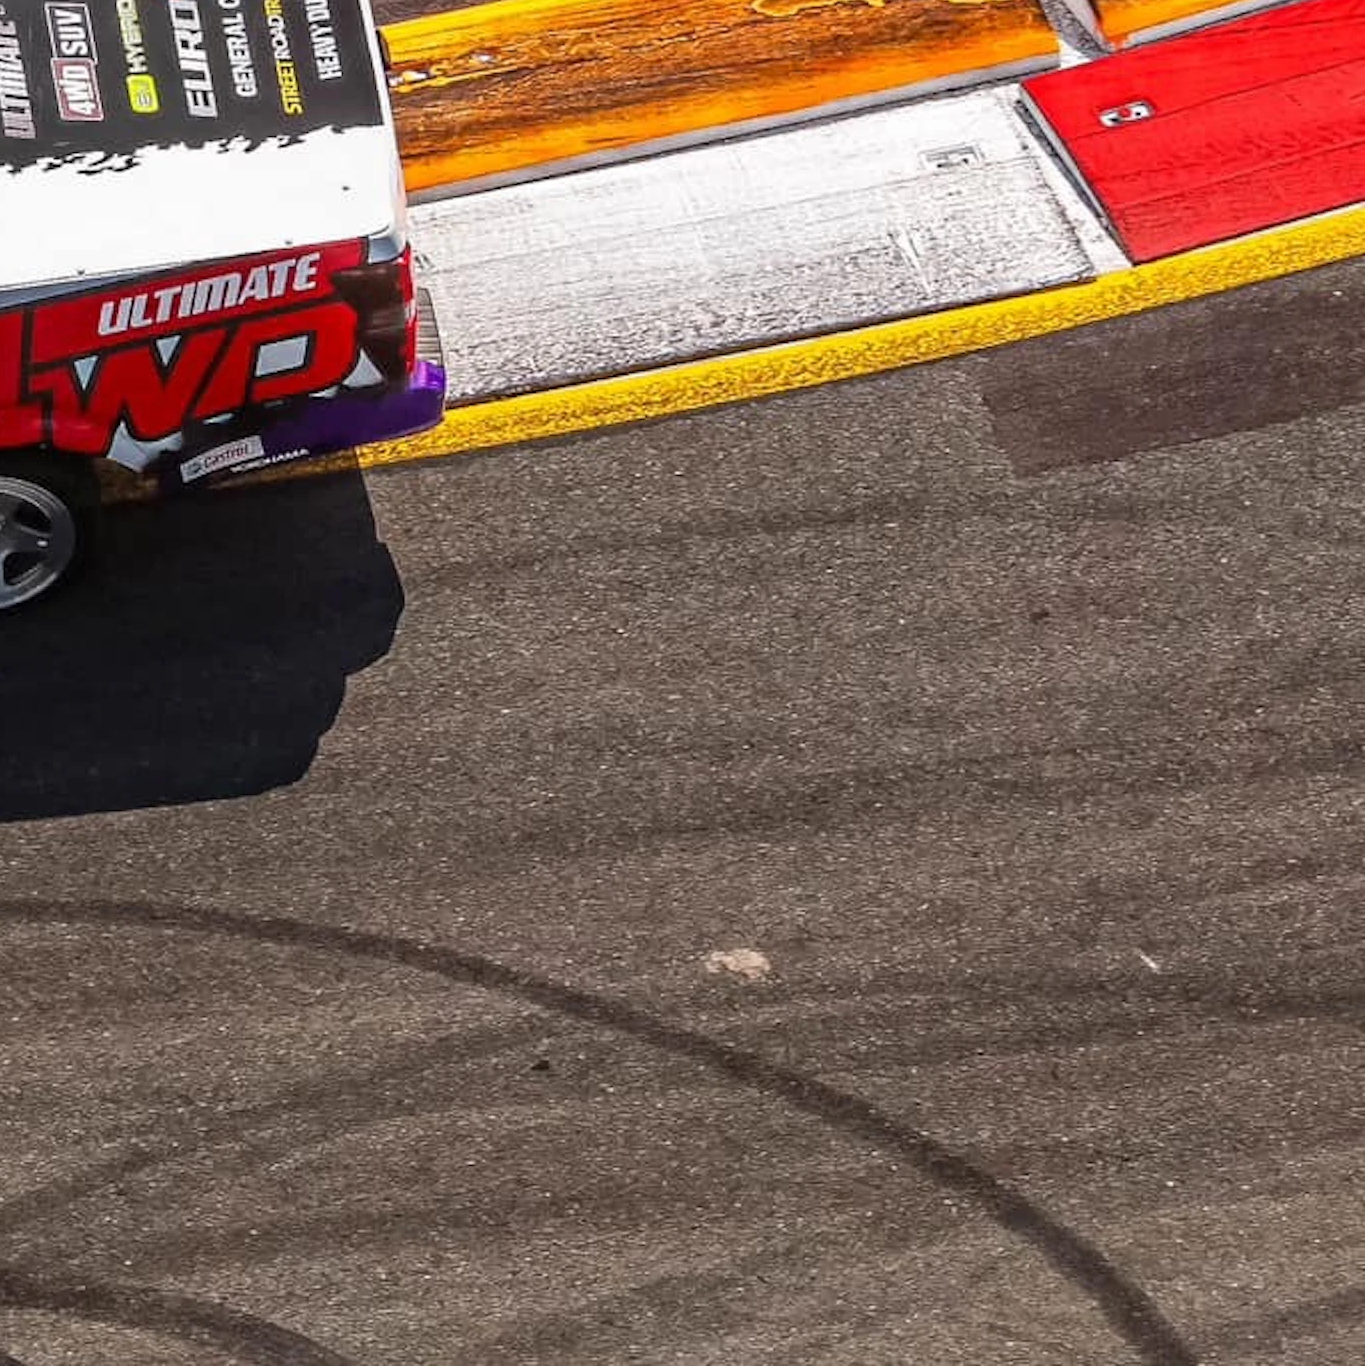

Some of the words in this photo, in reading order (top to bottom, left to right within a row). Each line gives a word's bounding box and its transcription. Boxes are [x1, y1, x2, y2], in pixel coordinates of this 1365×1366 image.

[54, 8, 89, 56] SUV
[221, 12, 259, 97] GENERAL
[308, 25, 343, 81] HEAVY
[58, 64, 97, 115] 4WD
[97, 251, 321, 336] ULTIMATE
